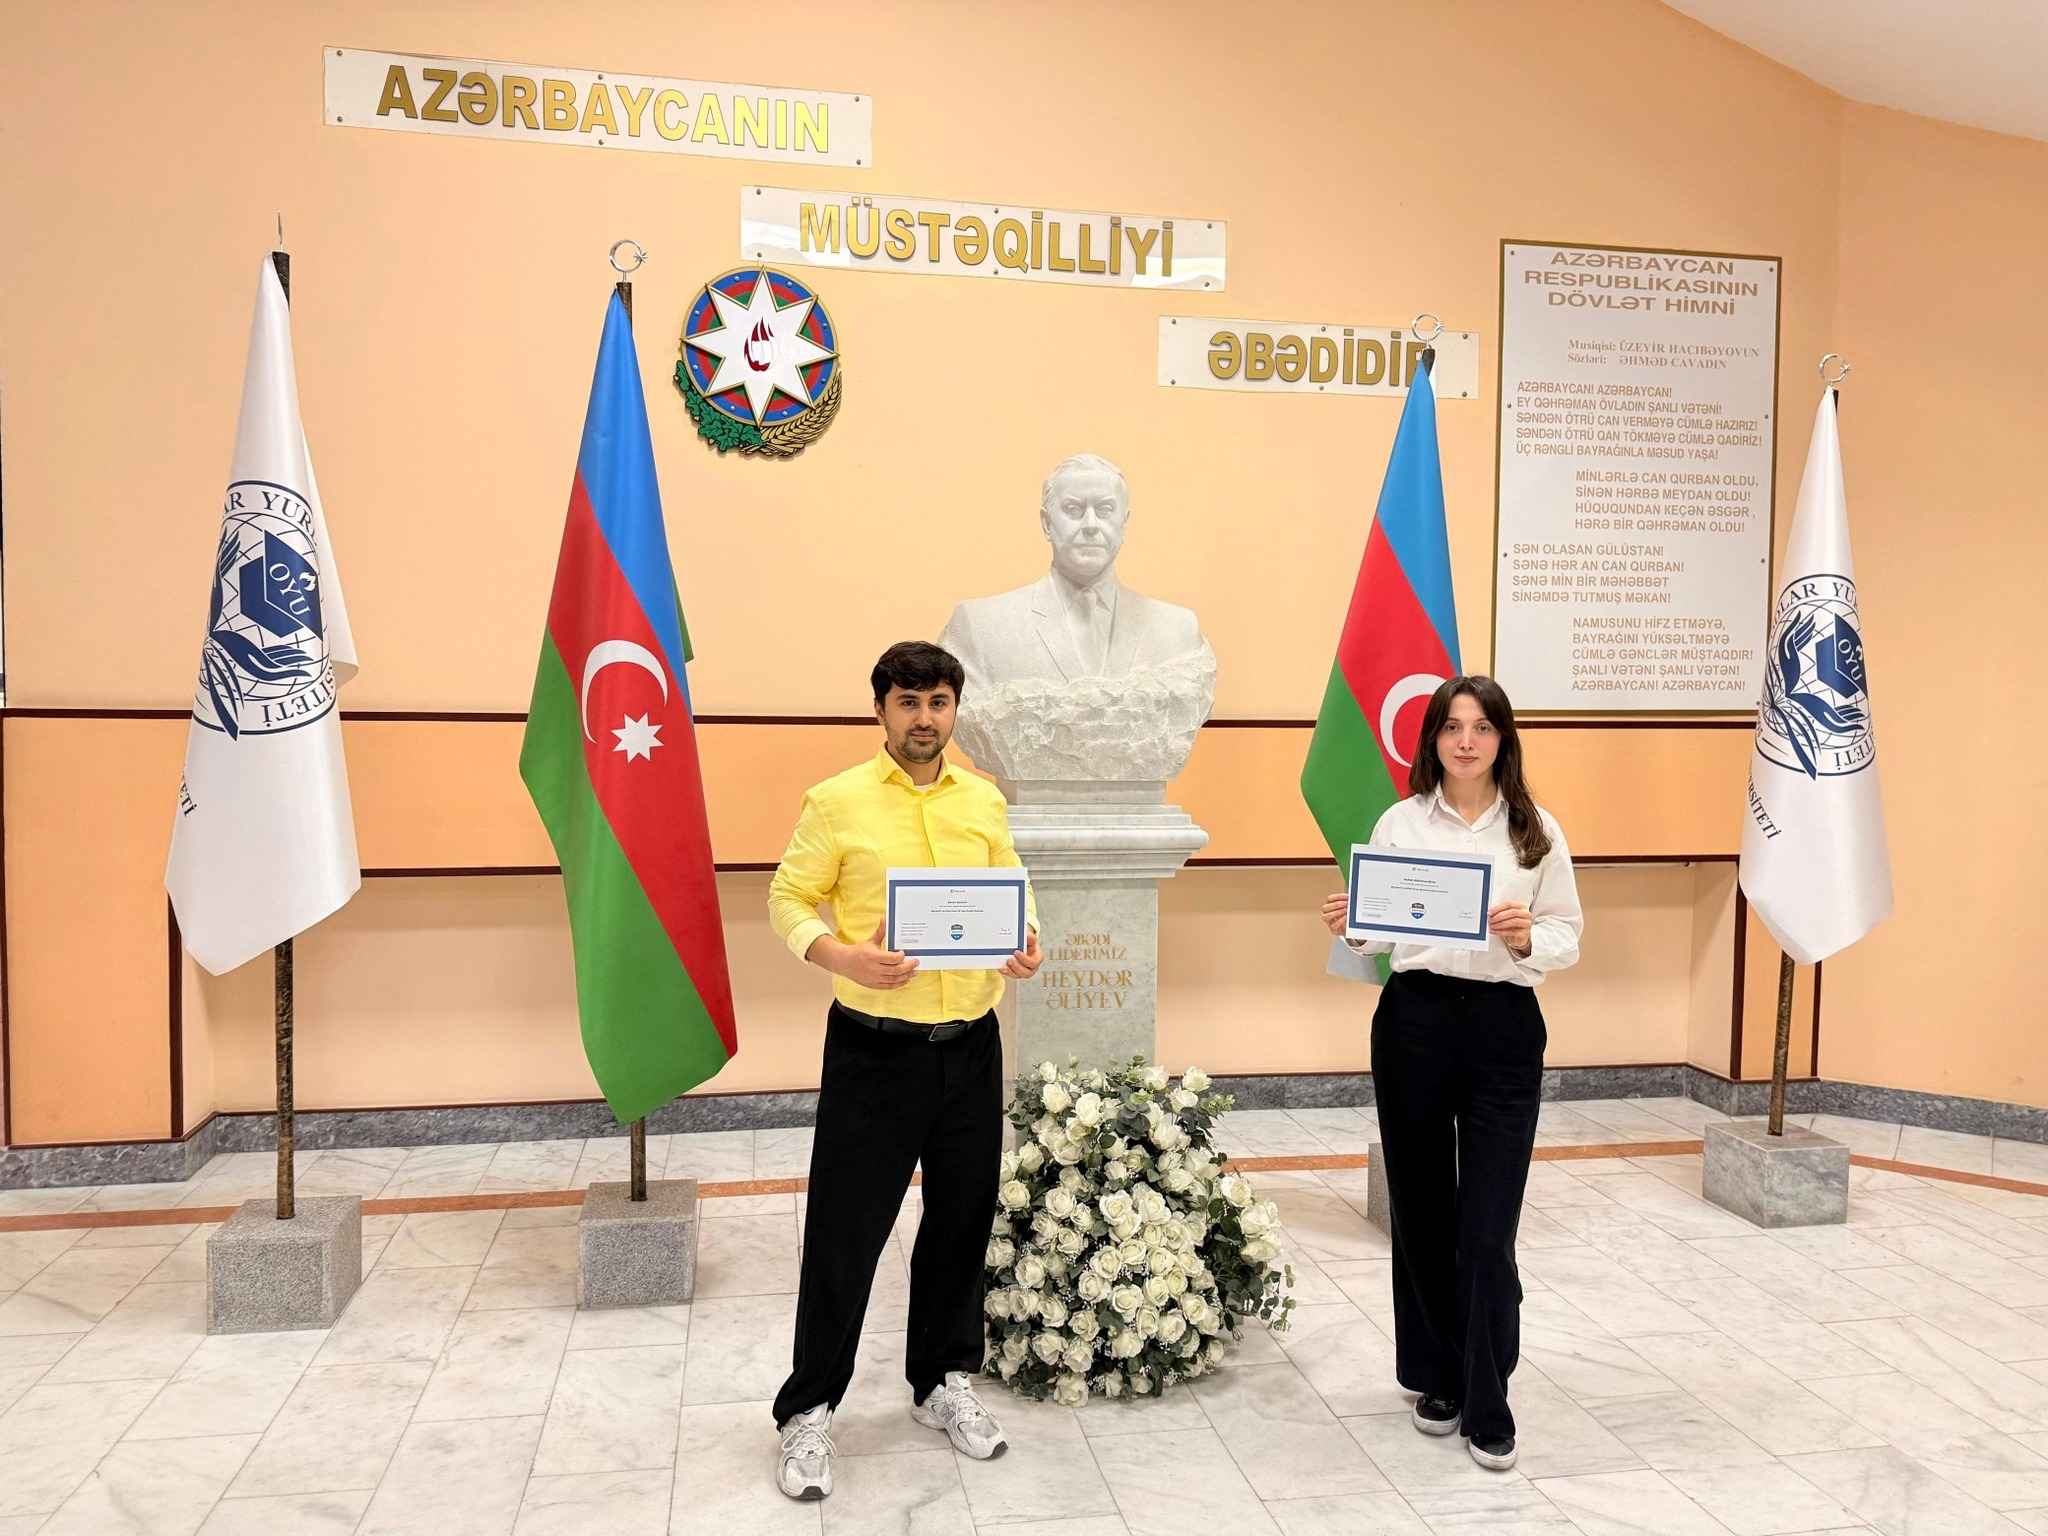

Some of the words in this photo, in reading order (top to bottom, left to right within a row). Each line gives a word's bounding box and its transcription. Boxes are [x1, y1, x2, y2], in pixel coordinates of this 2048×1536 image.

[376, 64, 829, 153] AZƏRBAYCANIN
[800, 197, 1174, 277] MÜSTƏQİLLİYİ
[1551, 251, 1734, 275] AZƏRBAYCAN
[1524, 270, 1758, 296] RESPUBLİKASININ
[1548, 290, 1656, 311] DÖVLƏT
[1665, 296, 1735, 315] HİMNİ
[1619, 340, 1665, 353] ÜZEYİR
[1619, 356, 1667, 367] ƏHMƏD
[1671, 358, 1727, 369] CAVADIN
[1518, 382, 1594, 394] AZƏRBAYCAN!
[1597, 387, 1672, 398] AZƏRBAYCAN!
[1517, 397, 1529, 407] EY
[1534, 398, 1596, 409] QƏHRƏMAN
[1648, 402, 1678, 415] ŞANLI
[1516, 413, 1562, 424] SƏNDƏN
[1566, 412, 1594, 425] ÖTRÜ
[1598, 415, 1619, 425] CAN
[1622, 414, 1674, 429] VERMƏYƏ
[1677, 417, 1712, 429] CÜMLƏ
[1516, 428, 1561, 439] SƏNDƏN
[1565, 427, 1594, 440] ÖTRÜ
[1597, 431, 1619, 441] QAN
[1679, 432, 1715, 444] CÜMLƏ
[1516, 442, 1531, 456] ÜÇ
[1647, 448, 1684, 458] MƏSUD
[1688, 449, 1719, 461] YAŞA!
[1576, 469, 1638, 482] MİNLƏRLƏ
[1641, 473, 1666, 483] CAN
[1670, 474, 1720, 485] QURBAN
[1576, 485, 1612, 497] SİNƏN
[1617, 488, 1659, 498] HƏRBƏ
[1663, 490, 1712, 500] MEYDAN
[1715, 491, 1751, 502] OLDU!
[1664, 504, 1704, 518] KEÇƏN
[1575, 519, 1609, 529] HƏRƏ
[1614, 517, 1633, 530] BİR
[1637, 520, 1706, 531] QƏHRƏMAN
[1709, 521, 1745, 532] OLDU!
[1513, 544, 1539, 554] SƏN
[1543, 544, 1592, 555] OLASAN
[1513, 560, 1548, 570] SƏNƏ
[1552, 560, 1577, 571] HƏR
[1582, 561, 1598, 571] AN
[1602, 561, 1626, 571] CAN
[1630, 561, 1685, 572] QURBAN!
[1512, 576, 1548, 586] SƏNƏ
[1552, 574, 1573, 586] MİN
[1577, 574, 1597, 587] BİR
[1600, 576, 1669, 587] MƏHƏBBƏT
[268, 563, 311, 616] OYU
[1512, 589, 1569, 602] SİNƏMDƏ
[1573, 592, 1621, 605] TUTMUŞ
[1625, 593, 1671, 604] MƏKAN!
[1573, 618, 1641, 629] NAMUSUNU
[1645, 616, 1670, 629] HİFZ
[1673, 618, 1726, 631] ETMƏYƏ,
[1572, 632, 1638, 644] BAYRAĞINI
[1642, 632, 1730, 645] YÜKSƏLTMƏYƏ
[1572, 647, 1615, 660] CÜMLƏ
[1619, 649, 1677, 660] GƏNCLƏR
[1837, 638, 1862, 681] OYU
[1572, 665, 1607, 676] ŞANLI
[1611, 665, 1655, 676] VƏTƏN!
[1659, 665, 1694, 677] ŞANLI
[1696, 665, 1740, 676] VƏTƏN!
[1572, 680, 1658, 691] AZƏRBAYCAN!
[1663, 680, 1745, 691] AZƏRBAYCAN!
